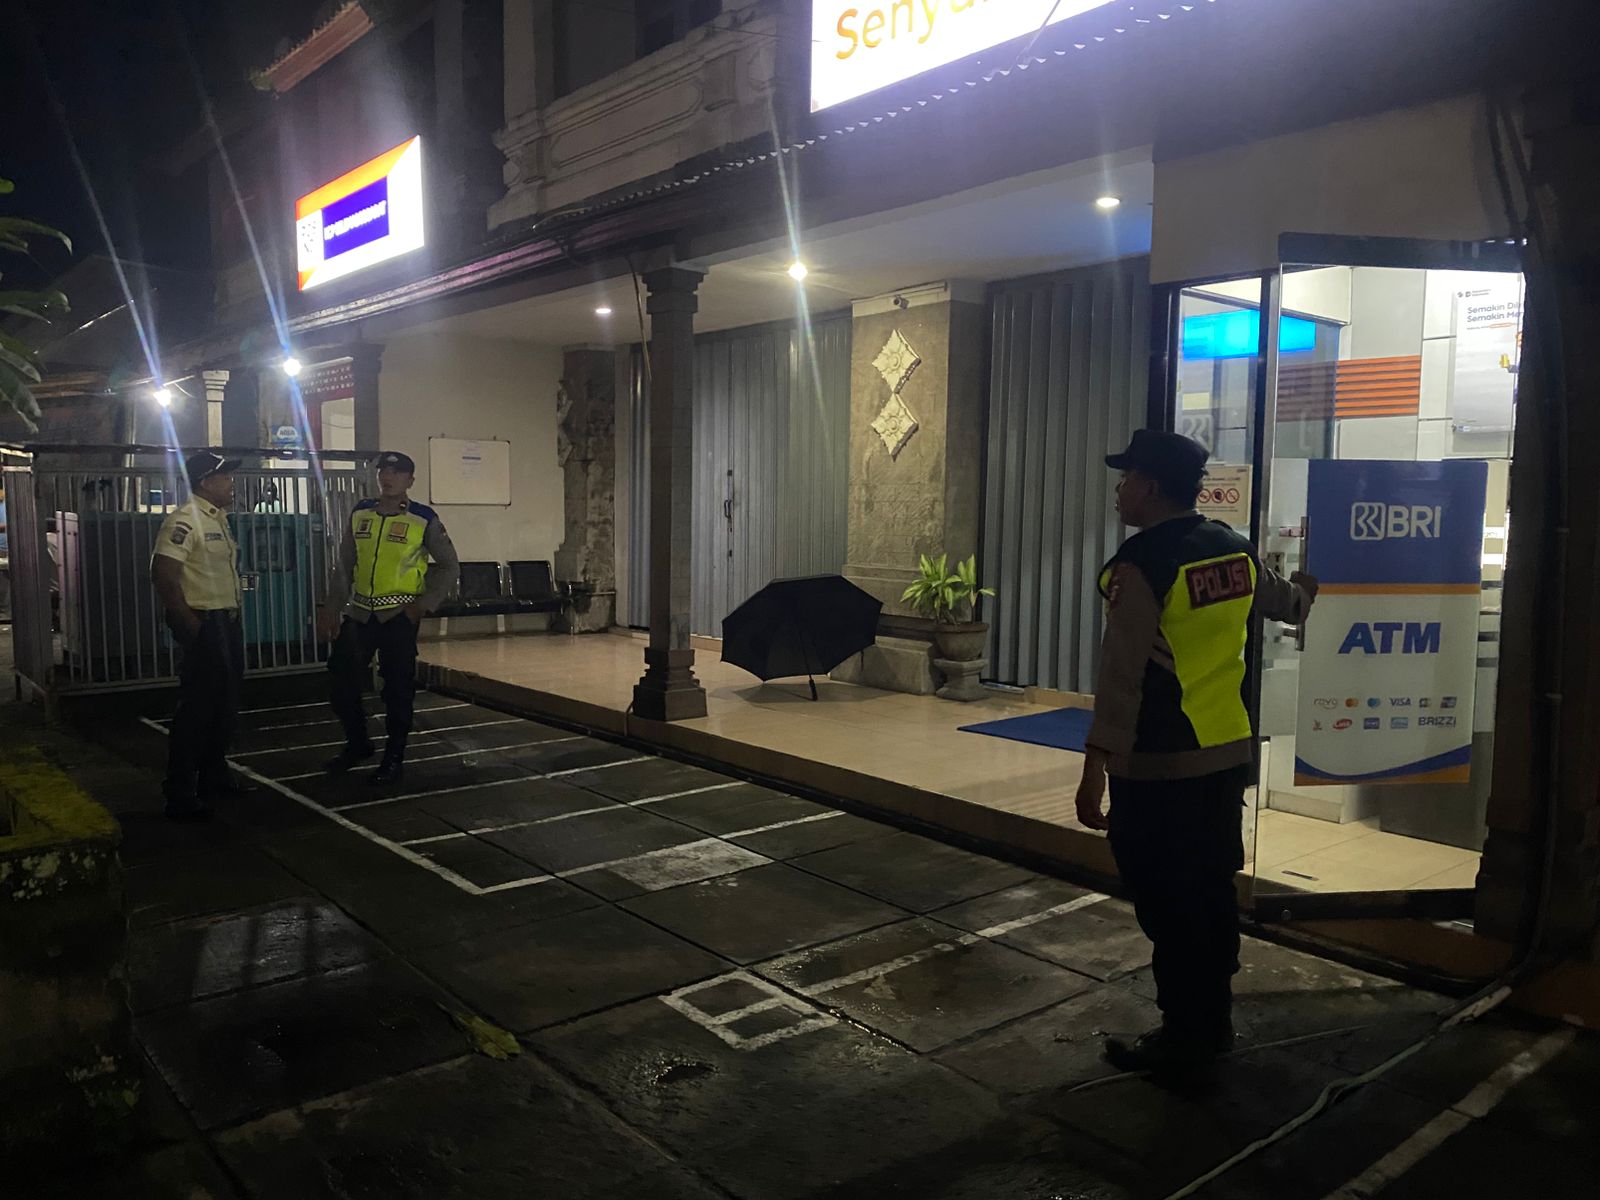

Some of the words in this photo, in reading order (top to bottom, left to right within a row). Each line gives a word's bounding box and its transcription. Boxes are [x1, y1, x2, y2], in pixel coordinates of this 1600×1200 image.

[1467, 304, 1505, 314] Semakin
[1466, 313, 1505, 322] Semakin
[1387, 505, 1442, 538] BRI
[1337, 622, 1442, 654] ATM
[1389, 697, 1411, 707] VISA
[1418, 716, 1457, 728] BRIZZI
